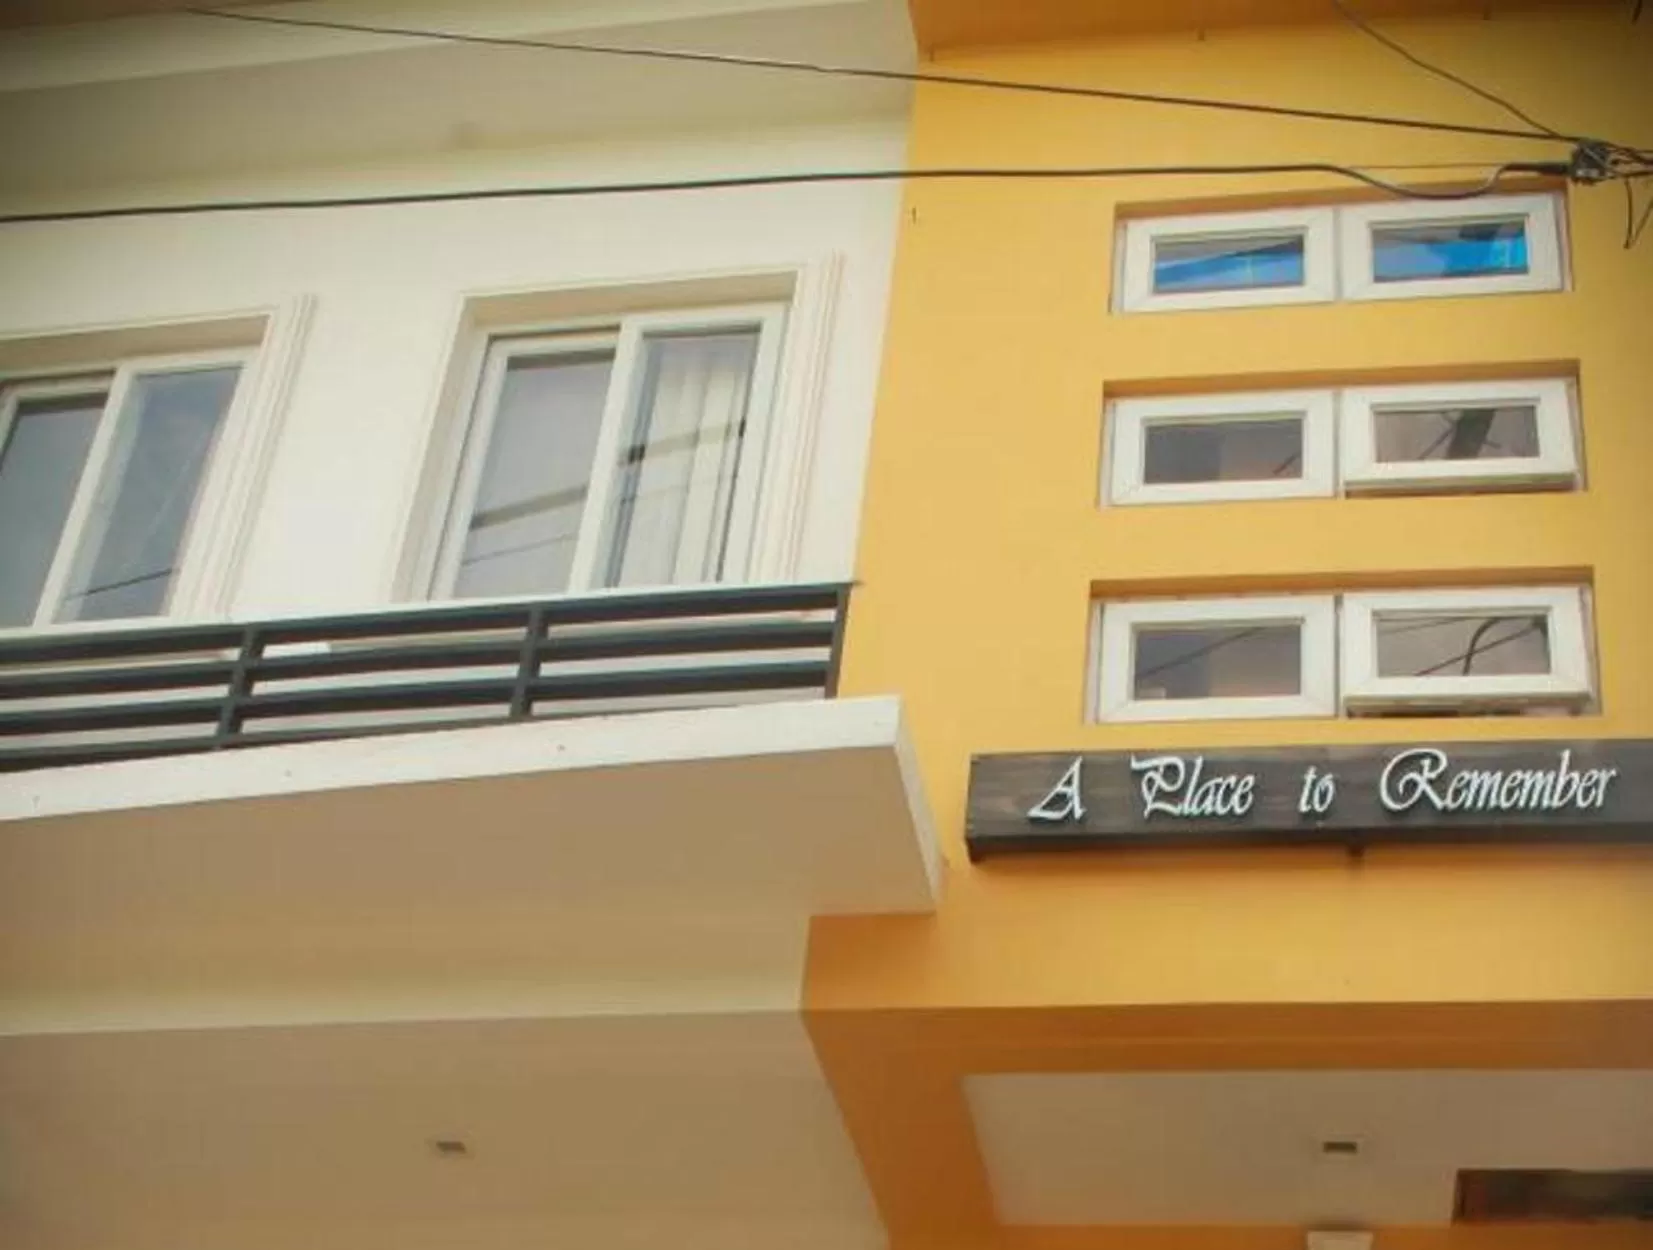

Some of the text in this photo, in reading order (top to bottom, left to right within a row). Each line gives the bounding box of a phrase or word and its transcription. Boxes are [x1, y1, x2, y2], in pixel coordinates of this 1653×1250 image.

[1027, 748, 1617, 820] A Place to Remember
